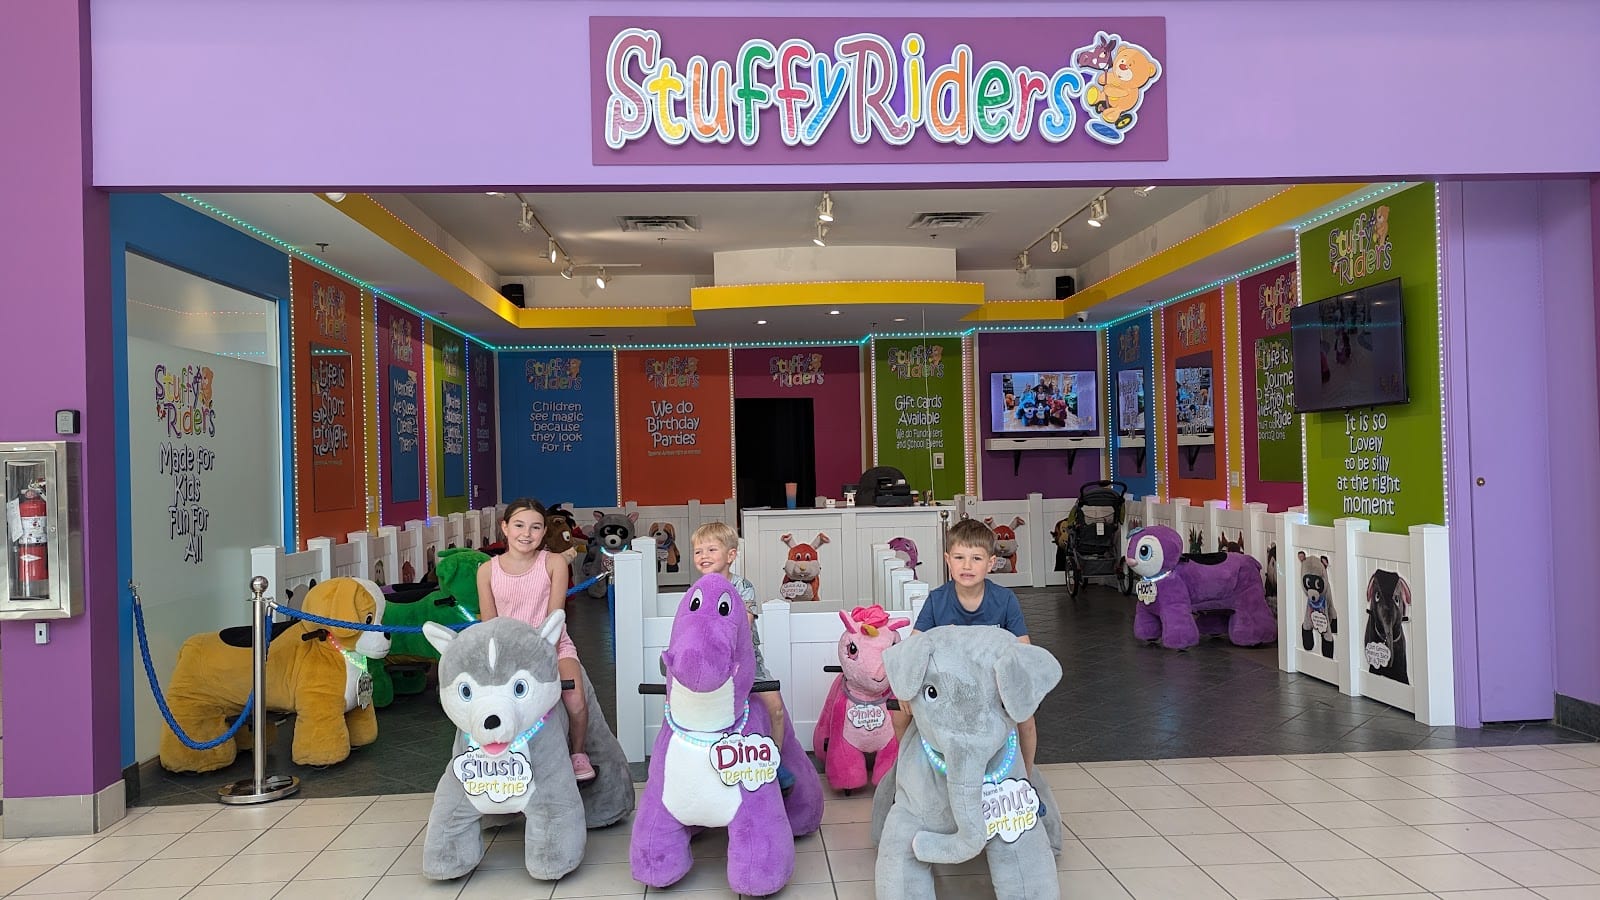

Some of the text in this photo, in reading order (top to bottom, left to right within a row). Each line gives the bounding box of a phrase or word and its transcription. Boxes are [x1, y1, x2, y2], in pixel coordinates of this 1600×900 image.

[1328, 211, 1375, 263] Stuffy
[1337, 240, 1392, 286] Riders
[1264, 306, 1291, 330] Ride
[154, 364, 202, 408] Stuffy
[1264, 370, 1294, 391] Journe
[532, 401, 582, 412] Children
[651, 400, 694, 417] We do
[895, 394, 943, 411] Gift Cards
[164, 403, 216, 438] Riders
[529, 411, 584, 422] see magic
[533, 421, 580, 432] because
[645, 416, 700, 432] Birthday
[897, 411, 940, 426] Available
[1344, 412, 1387, 436] It is so
[530, 432, 583, 442] they look
[541, 442, 573, 452] for it
[651, 431, 696, 448] Parties
[1350, 434, 1383, 454] Lovely
[160, 442, 215, 475] Made for
[1344, 455, 1390, 475] to be silly
[174, 474, 200, 507] Kids
[1337, 475, 1400, 494] at the right
[1343, 493, 1395, 516] moment
[168, 506, 190, 540] Fun
[184, 533, 203, 564] All
[715, 741, 771, 770] Dina
[461, 757, 524, 782] Slush
[722, 767, 775, 785] Rent me
[466, 780, 525, 795] Rent me
[981, 782, 1034, 820] eanut
[987, 812, 1034, 836] ent me
